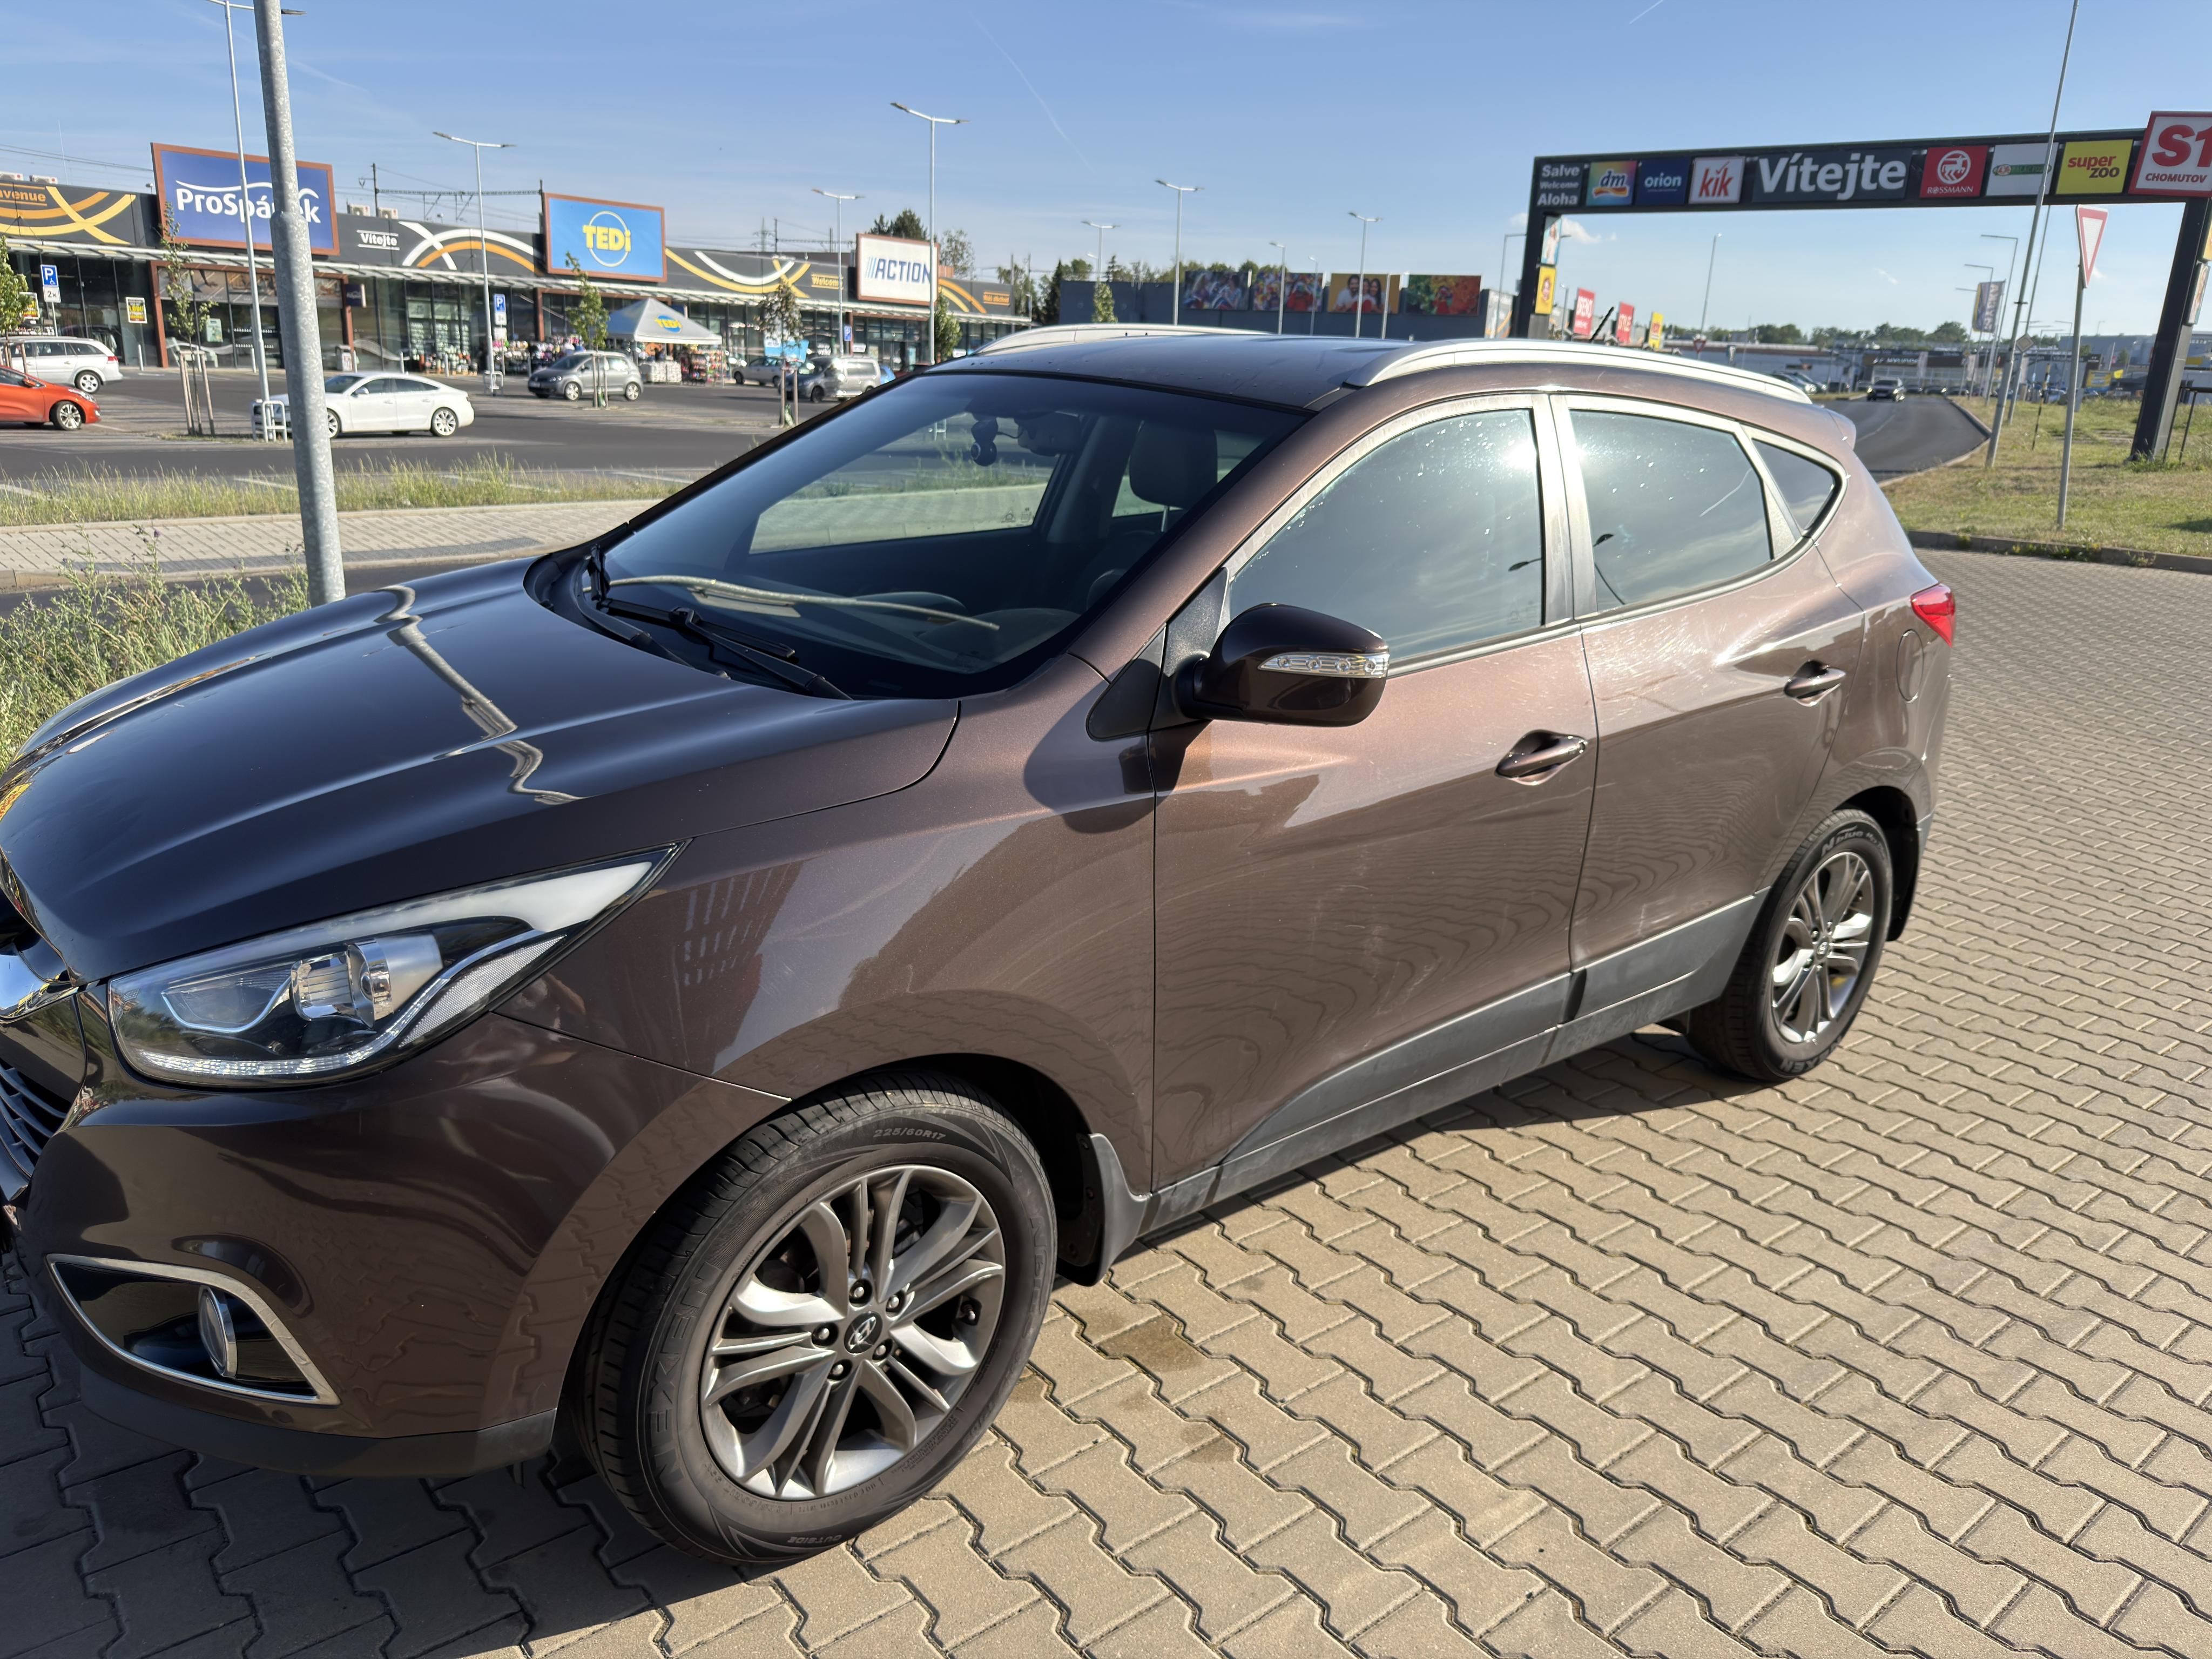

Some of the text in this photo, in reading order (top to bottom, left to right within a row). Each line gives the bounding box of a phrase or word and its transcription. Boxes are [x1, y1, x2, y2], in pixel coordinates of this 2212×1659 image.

[2152, 124, 2212, 167] S1
[1542, 164, 1580, 177] Salve
[2068, 156, 2117, 171] super
[1600, 170, 1627, 187] dm
[1644, 172, 1682, 187] orion
[1759, 152, 1906, 201] Vítejte
[2145, 172, 2208, 183] CHOMUTOV
[1540, 181, 1579, 190] Welcome
[1927, 186, 1974, 194] ROSSMANN
[176, 188, 321, 223] ProSpák
[1537, 193, 1578, 205] Aloha
[583, 225, 631, 252] TEDi
[44, 267, 53, 281] P
[875, 258, 932, 284] ACTION
[47, 290, 57, 298] 2x
[496, 296, 504, 306] P
[873, 1127, 947, 1140] 225/60R17
[650, 1262, 718, 1485] NEXEN
[787, 1534, 842, 1543] OUTSIDE
